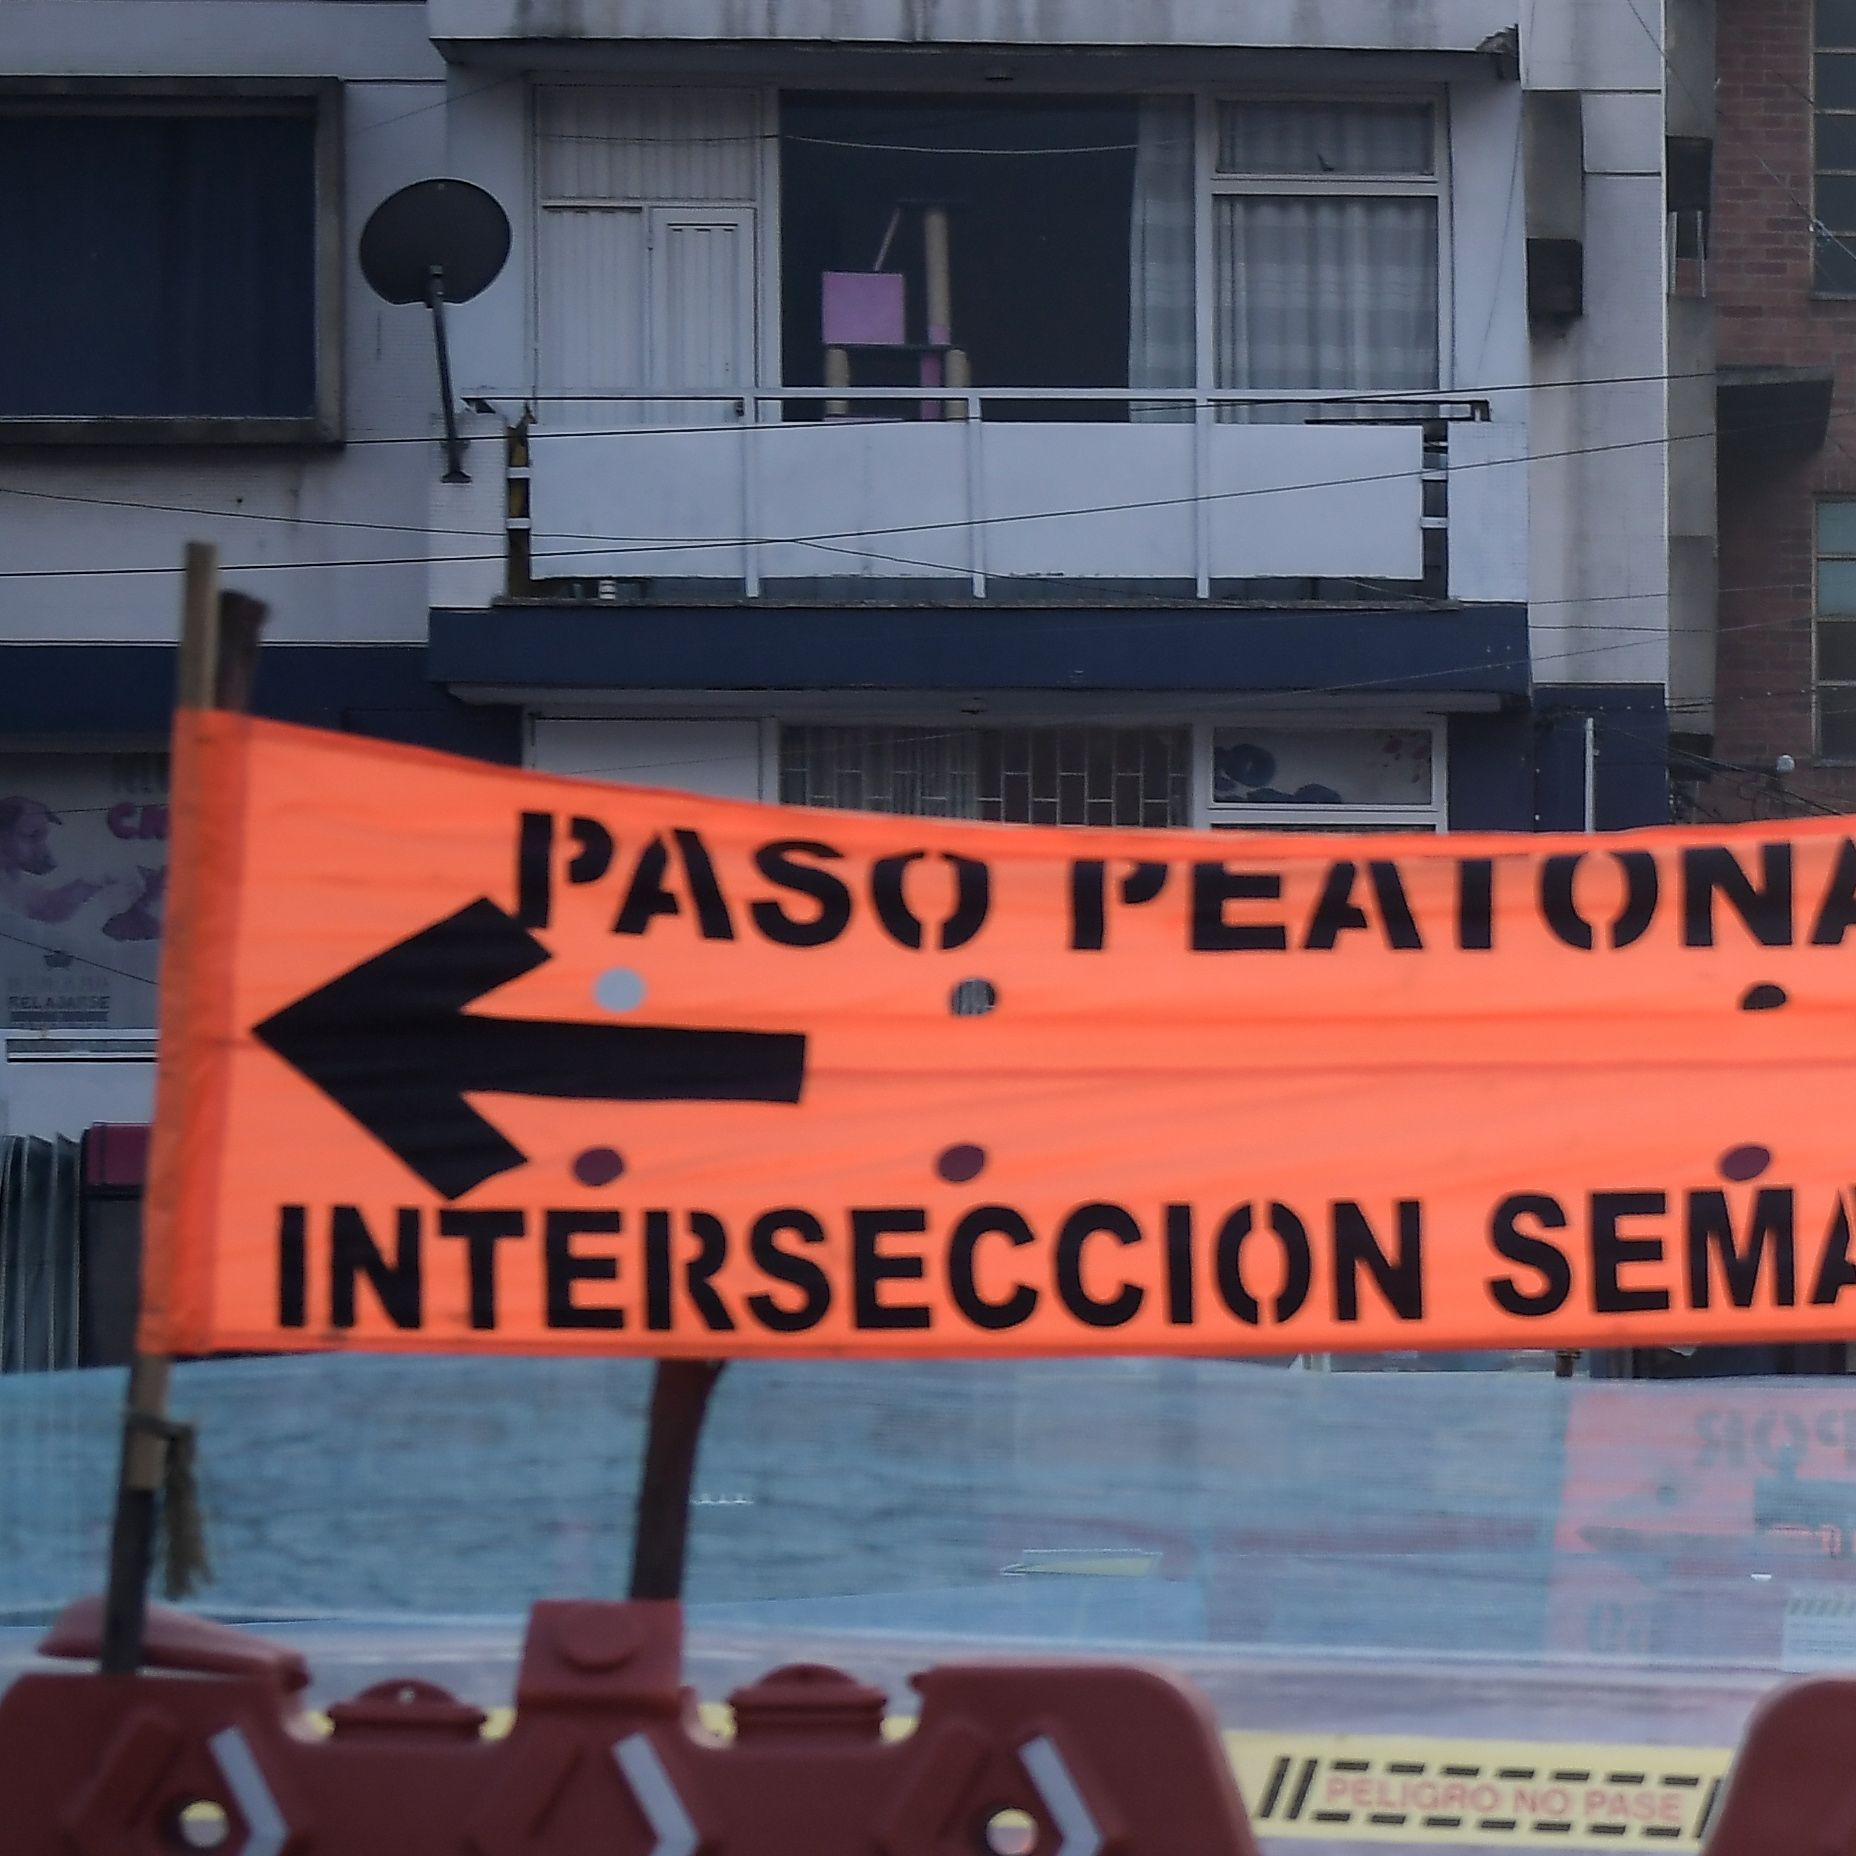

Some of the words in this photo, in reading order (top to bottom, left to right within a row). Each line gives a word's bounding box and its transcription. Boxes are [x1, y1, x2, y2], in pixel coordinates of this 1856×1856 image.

[519, 810, 990, 951] PASO
[279, 1199, 1424, 1333] INTERSECCION
[1326, 1776, 1500, 1814] PELIGRO
[1513, 1787, 1574, 1816] NO
[1583, 1791, 1683, 1823] PASE
